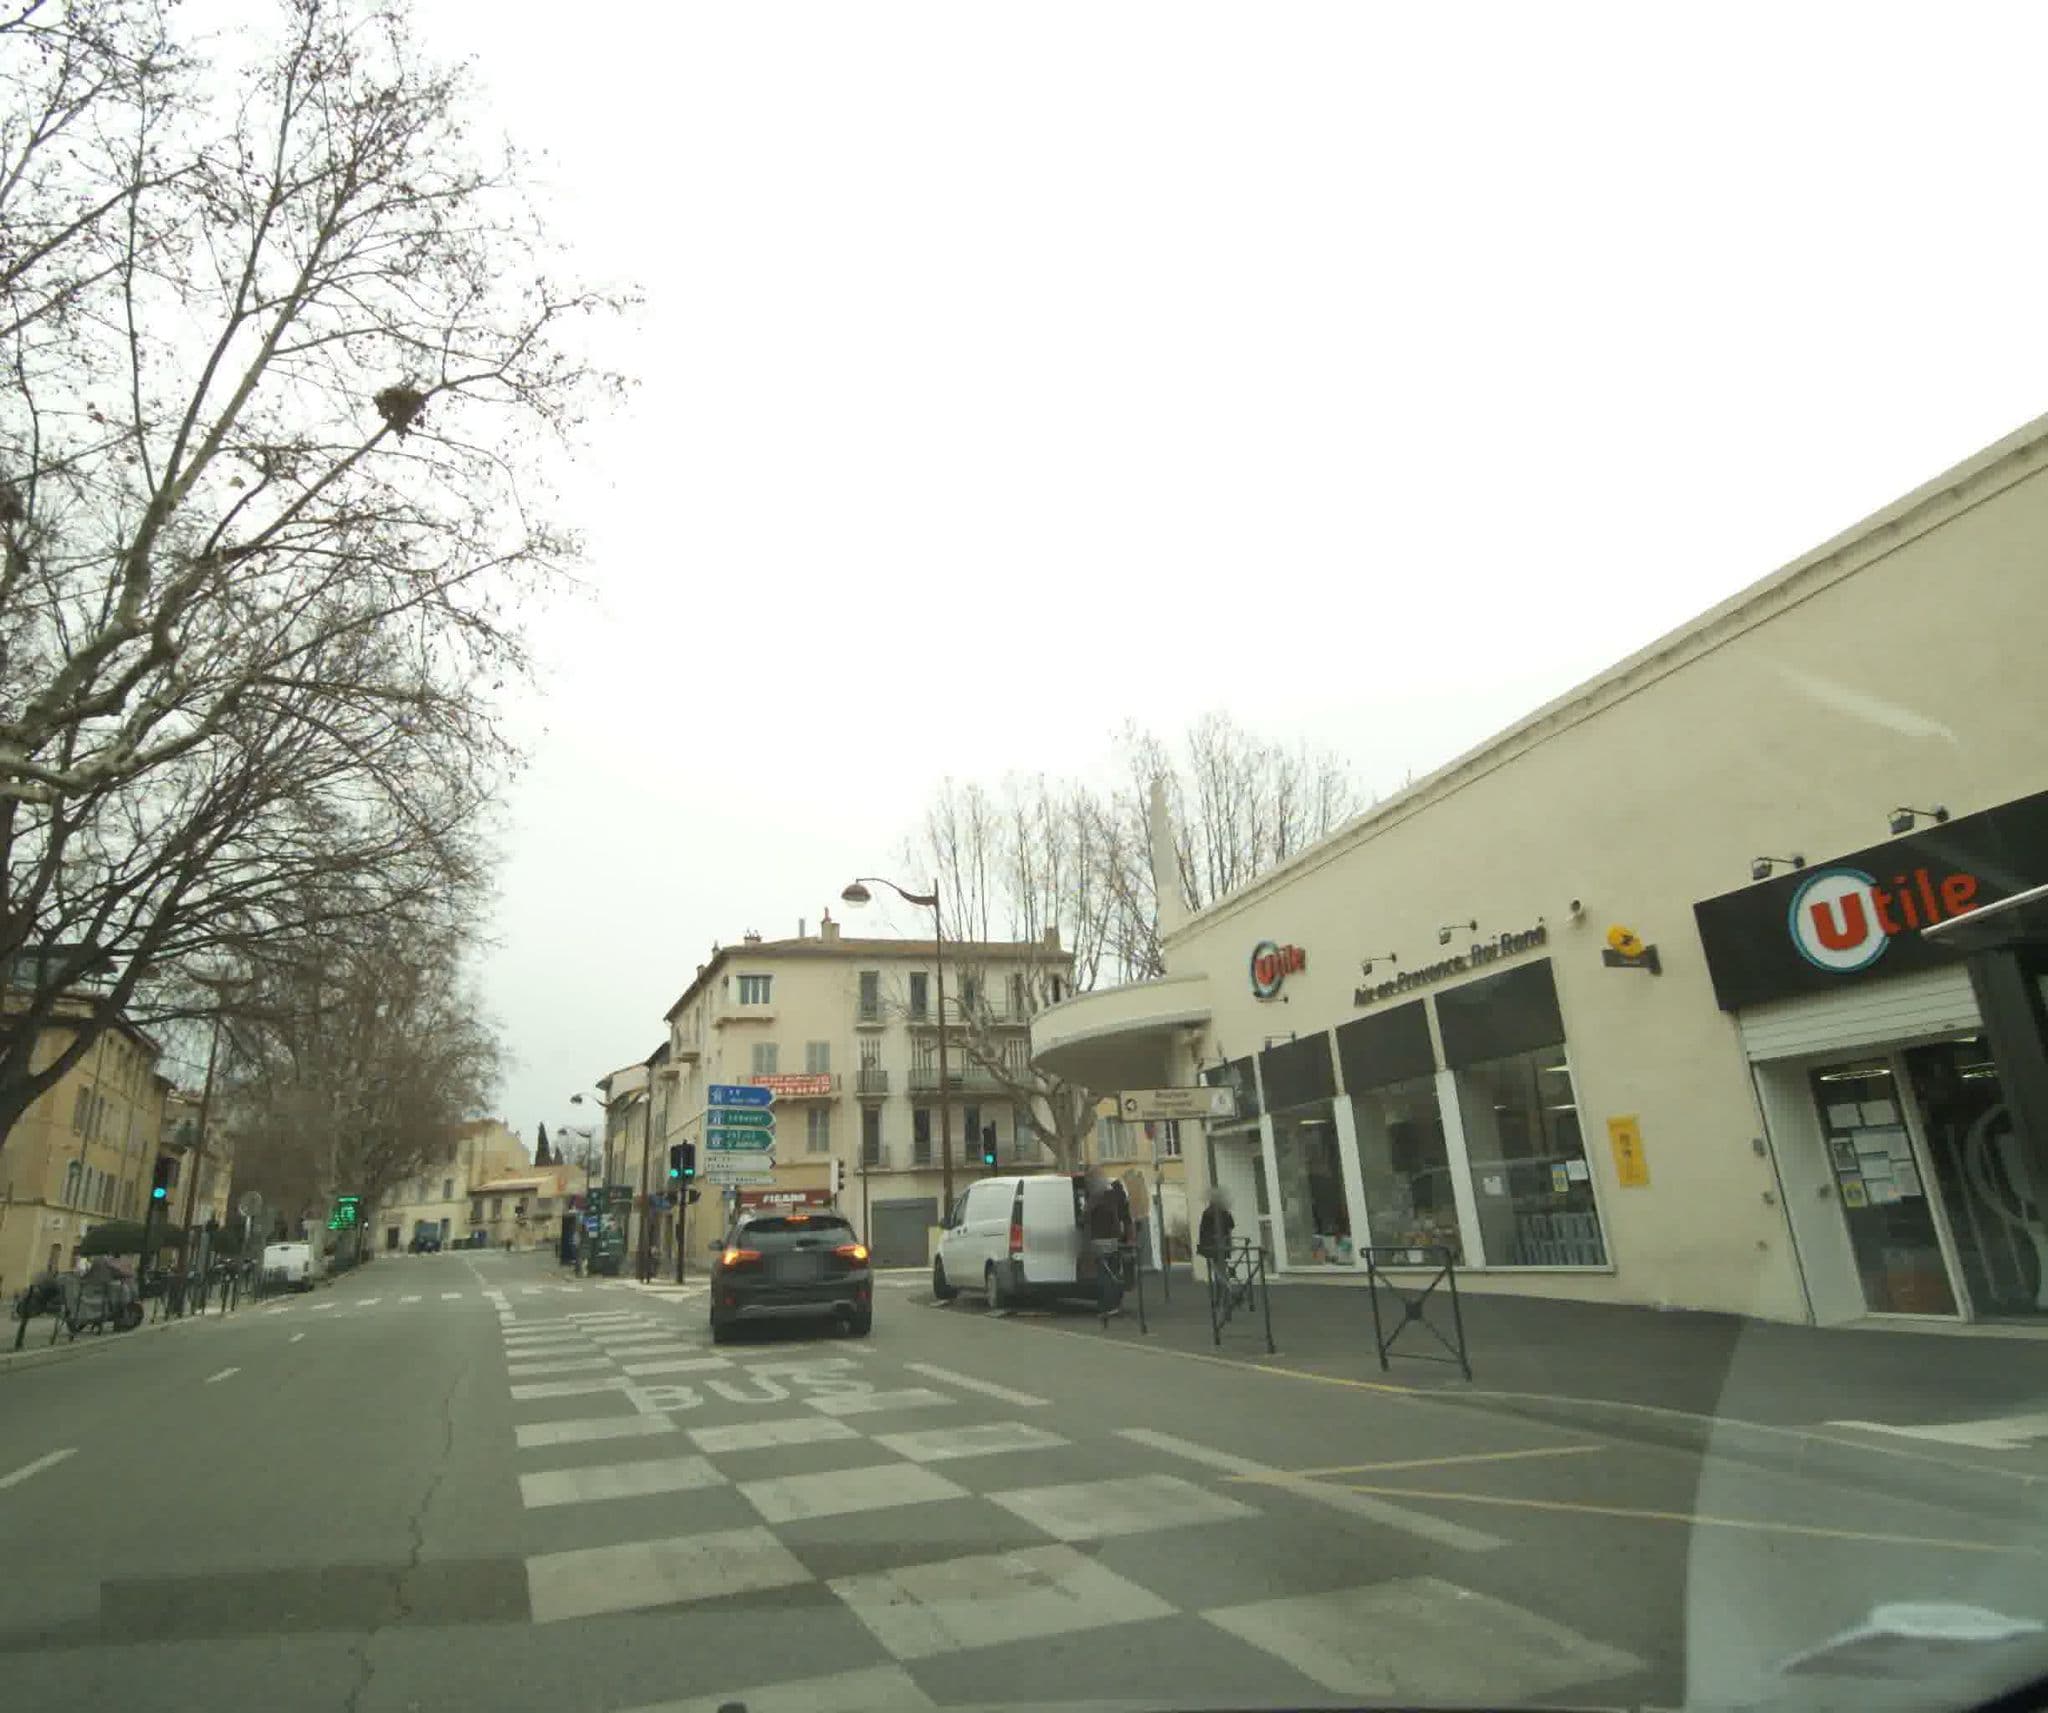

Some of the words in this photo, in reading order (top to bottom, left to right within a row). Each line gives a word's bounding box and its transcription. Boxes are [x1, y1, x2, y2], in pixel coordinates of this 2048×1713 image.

[1810, 869, 1979, 950] Utile
[1255, 945, 1306, 986] Utile
[624, 1366, 875, 1413] BUS
